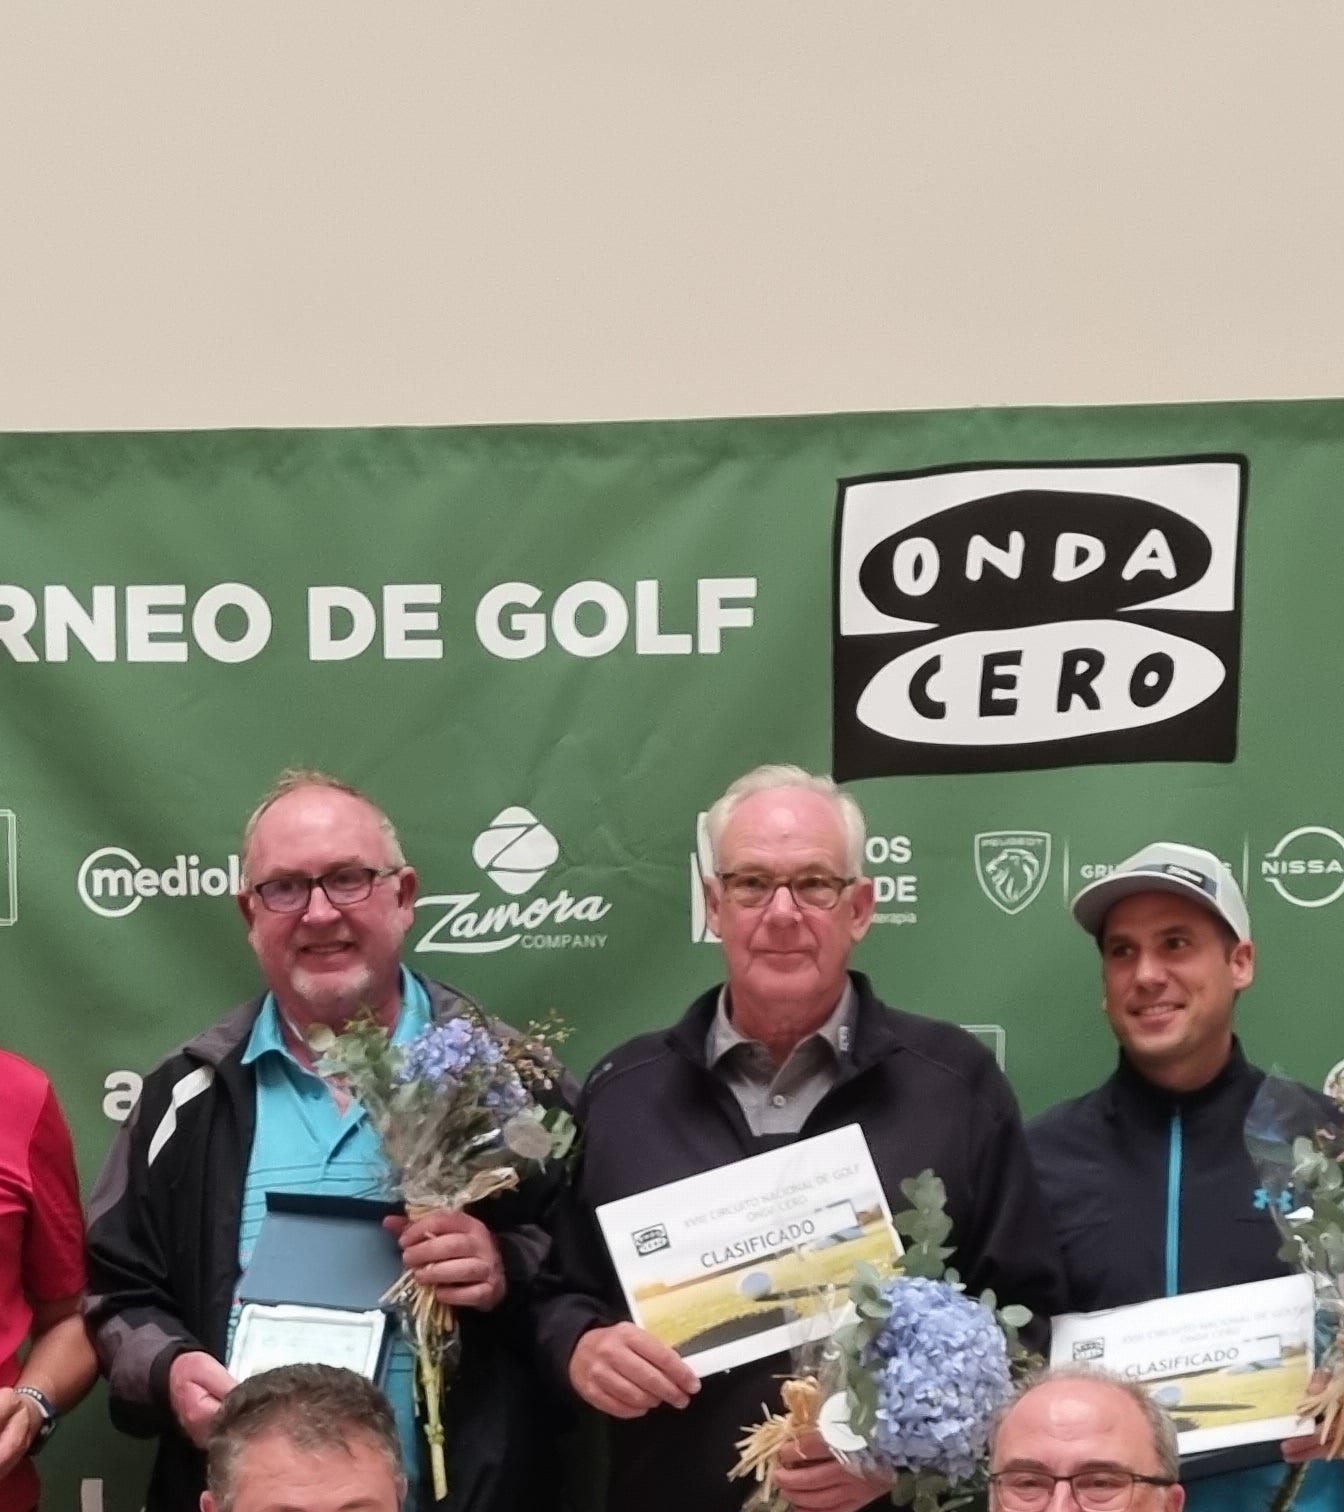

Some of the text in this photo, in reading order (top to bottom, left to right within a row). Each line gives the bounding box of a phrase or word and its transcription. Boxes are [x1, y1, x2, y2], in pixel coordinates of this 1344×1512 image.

[892, 528, 1177, 596] ONDA
[309, 584, 443, 661] DE
[475, 577, 757, 660] GOLF
[908, 648, 1175, 719] CERO
[91, 854, 244, 897] mediol
[413, 889, 613, 954] Zamora
[520, 933, 608, 949] COMPANY
[815, 1173, 831, 1187] DE
[832, 1163, 861, 1181] GOLF
[700, 1219, 816, 1268] CLASIFICADO
[1124, 1347, 1240, 1378] CLASIFICADO
